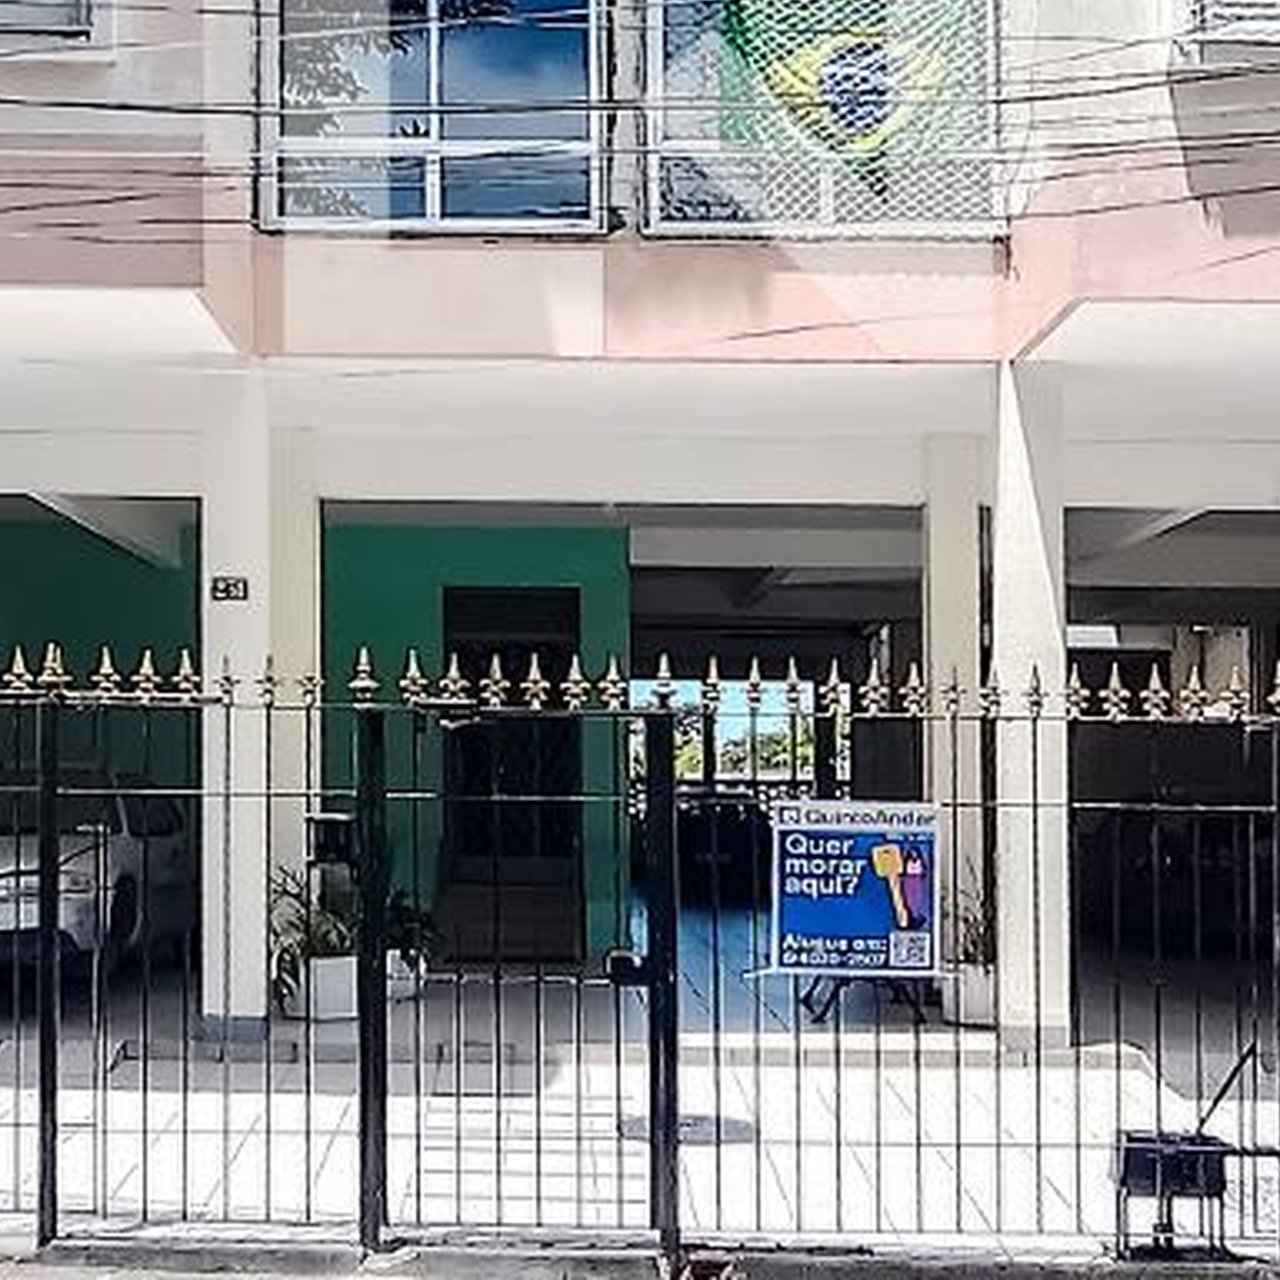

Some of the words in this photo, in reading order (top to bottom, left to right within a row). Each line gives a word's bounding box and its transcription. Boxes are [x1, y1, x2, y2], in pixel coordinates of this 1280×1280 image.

[786, 833, 854, 855] Quer
[785, 859, 866, 874] morar
[785, 876, 858, 898] aqui?
